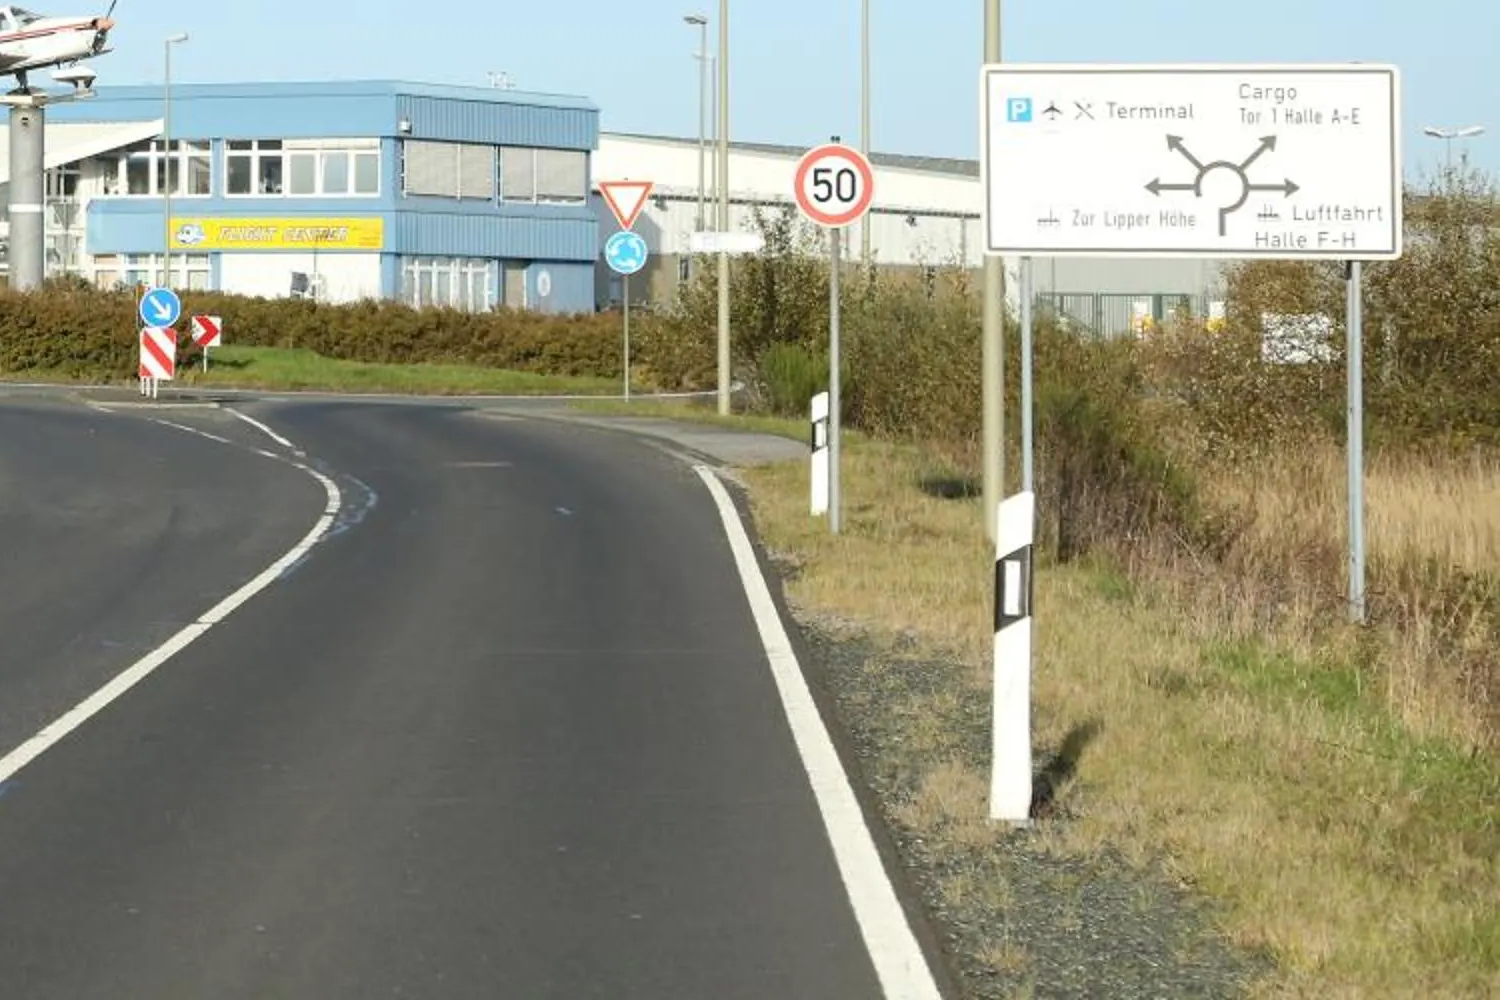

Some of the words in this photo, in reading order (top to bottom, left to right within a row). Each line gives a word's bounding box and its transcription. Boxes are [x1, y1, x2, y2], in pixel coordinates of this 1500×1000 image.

[1238, 83, 1298, 105] Cargo
[1106, 101, 1195, 120] Terminal
[1239, 107, 1261, 125] Tor
[1271, 107, 1278, 125] 1
[1285, 107, 1324, 125] Halle
[1331, 107, 1361, 125] A-E
[813, 167, 856, 203] 50
[1072, 208, 1097, 227] Zur
[1104, 210, 1150, 230] Lipper
[1159, 207, 1198, 227] Höhe
[1293, 204, 1383, 221] Luftfahrt
[1255, 231, 1307, 248] Halle
[1317, 231, 1356, 248] F-H
